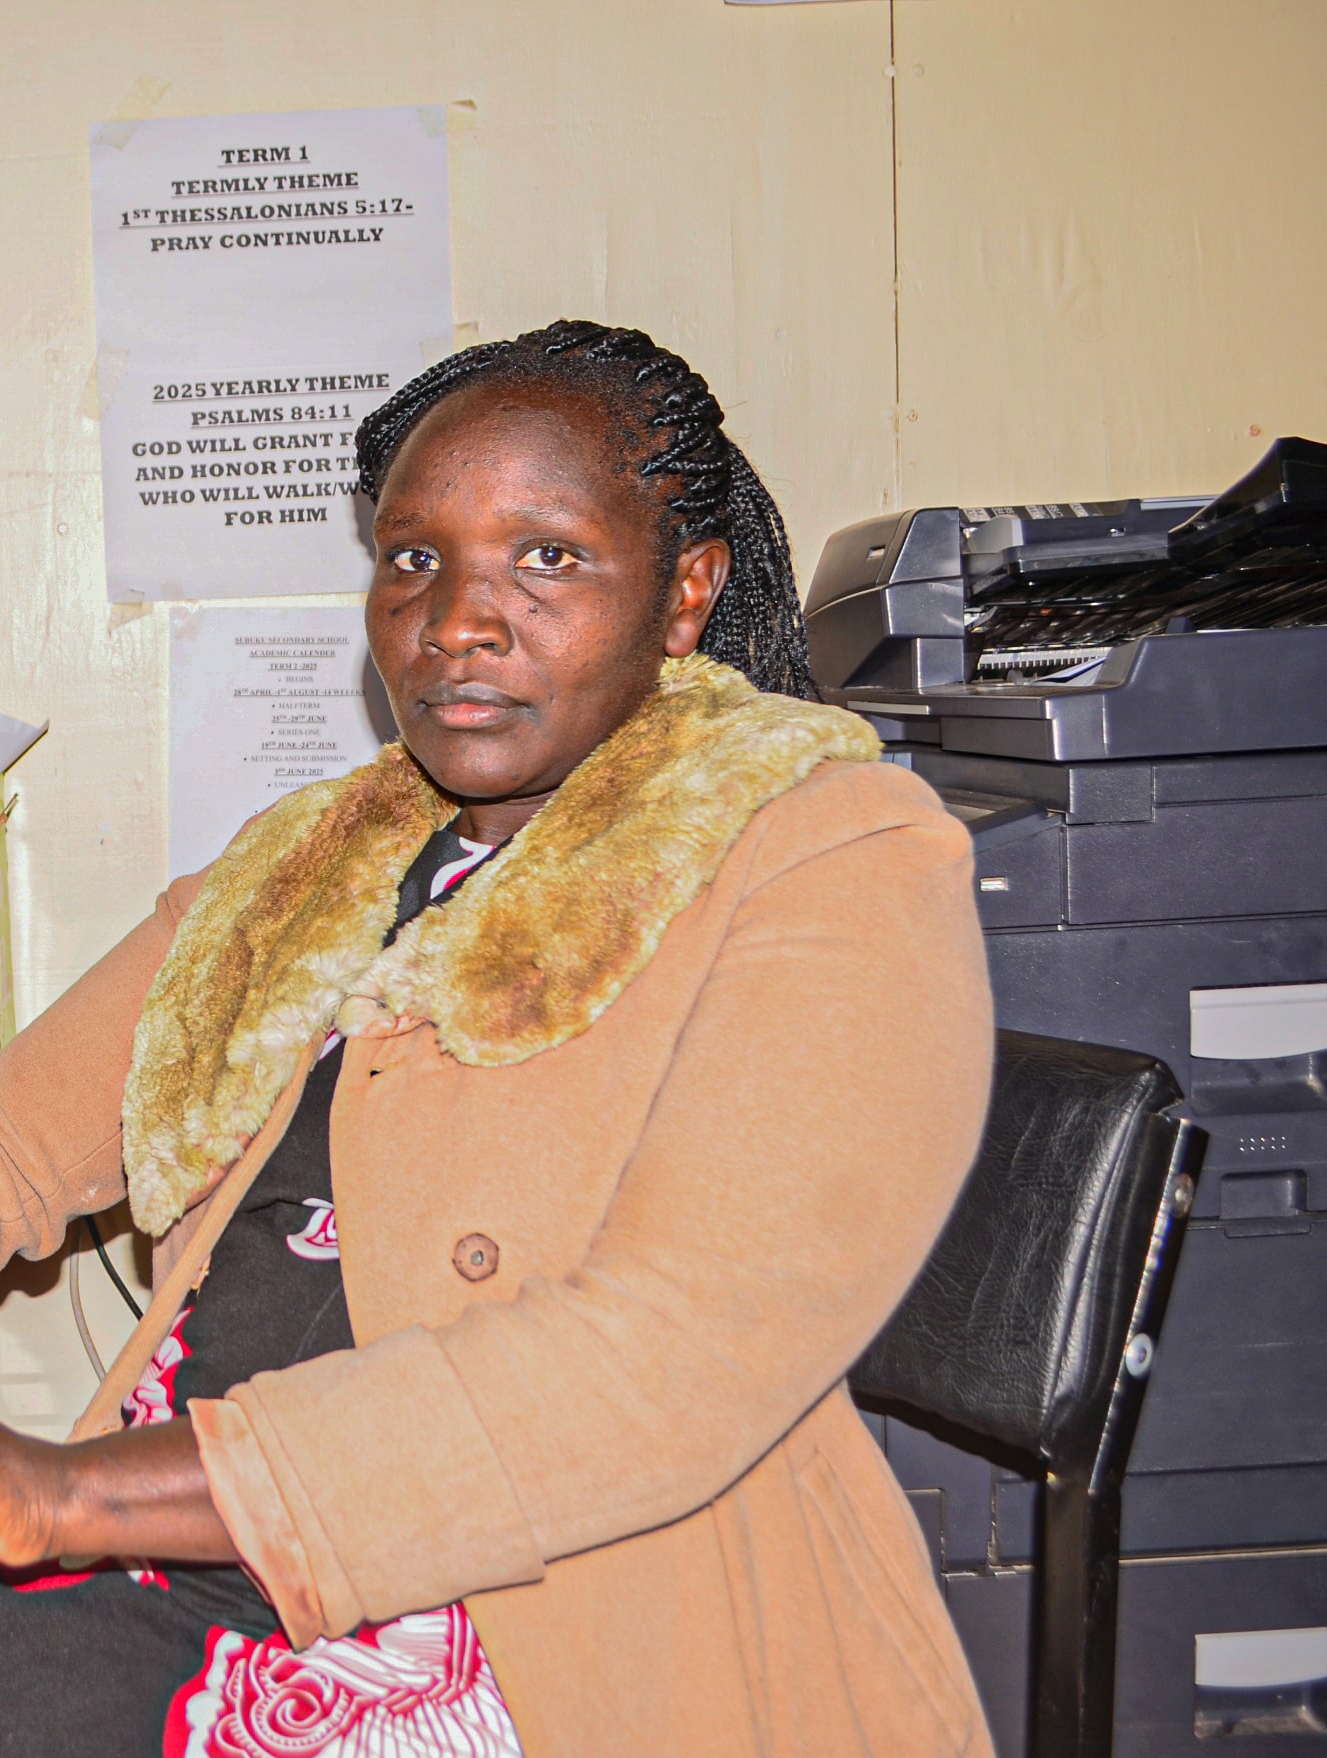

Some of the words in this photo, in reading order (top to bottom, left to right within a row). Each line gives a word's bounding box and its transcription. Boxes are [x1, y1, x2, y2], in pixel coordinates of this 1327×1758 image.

[221, 146, 291, 165] TERM
[299, 145, 310, 163] 1
[171, 175, 270, 196] TERMLY
[273, 172, 359, 191] THEME
[121, 207, 152, 227] 1ST
[155, 199, 349, 225] THESSALONIANS
[150, 235, 214, 253] PRAY
[219, 227, 385, 250] CONTINUALLY
[153, 382, 208, 401] 2025
[210, 377, 301, 397] YEARLY
[304, 373, 391, 392] THEME
[191, 406, 285, 427] PSALMS
[290, 403, 353, 421] 84:11
[132, 441, 183, 458] GOD
[186, 436, 247, 455] WILL
[252, 432, 334, 451] GRANT
[135, 465, 185, 482] AND
[190, 460, 278, 479] HONOR
[283, 457, 331, 475] FOR
[138, 488, 196, 506] WHO
[199, 486, 260, 504] WILL
[263, 481, 361, 500] WALK/W
[224, 510, 273, 526] FOR
[278, 507, 329, 524] HIM
[267, 636, 316, 644] SECONDARY
[318, 636, 349, 644] SCHOOL
[250, 688, 272, 696] APRIL
[318, 741, 338, 749] JUNE
[284, 754, 301, 762] AND
